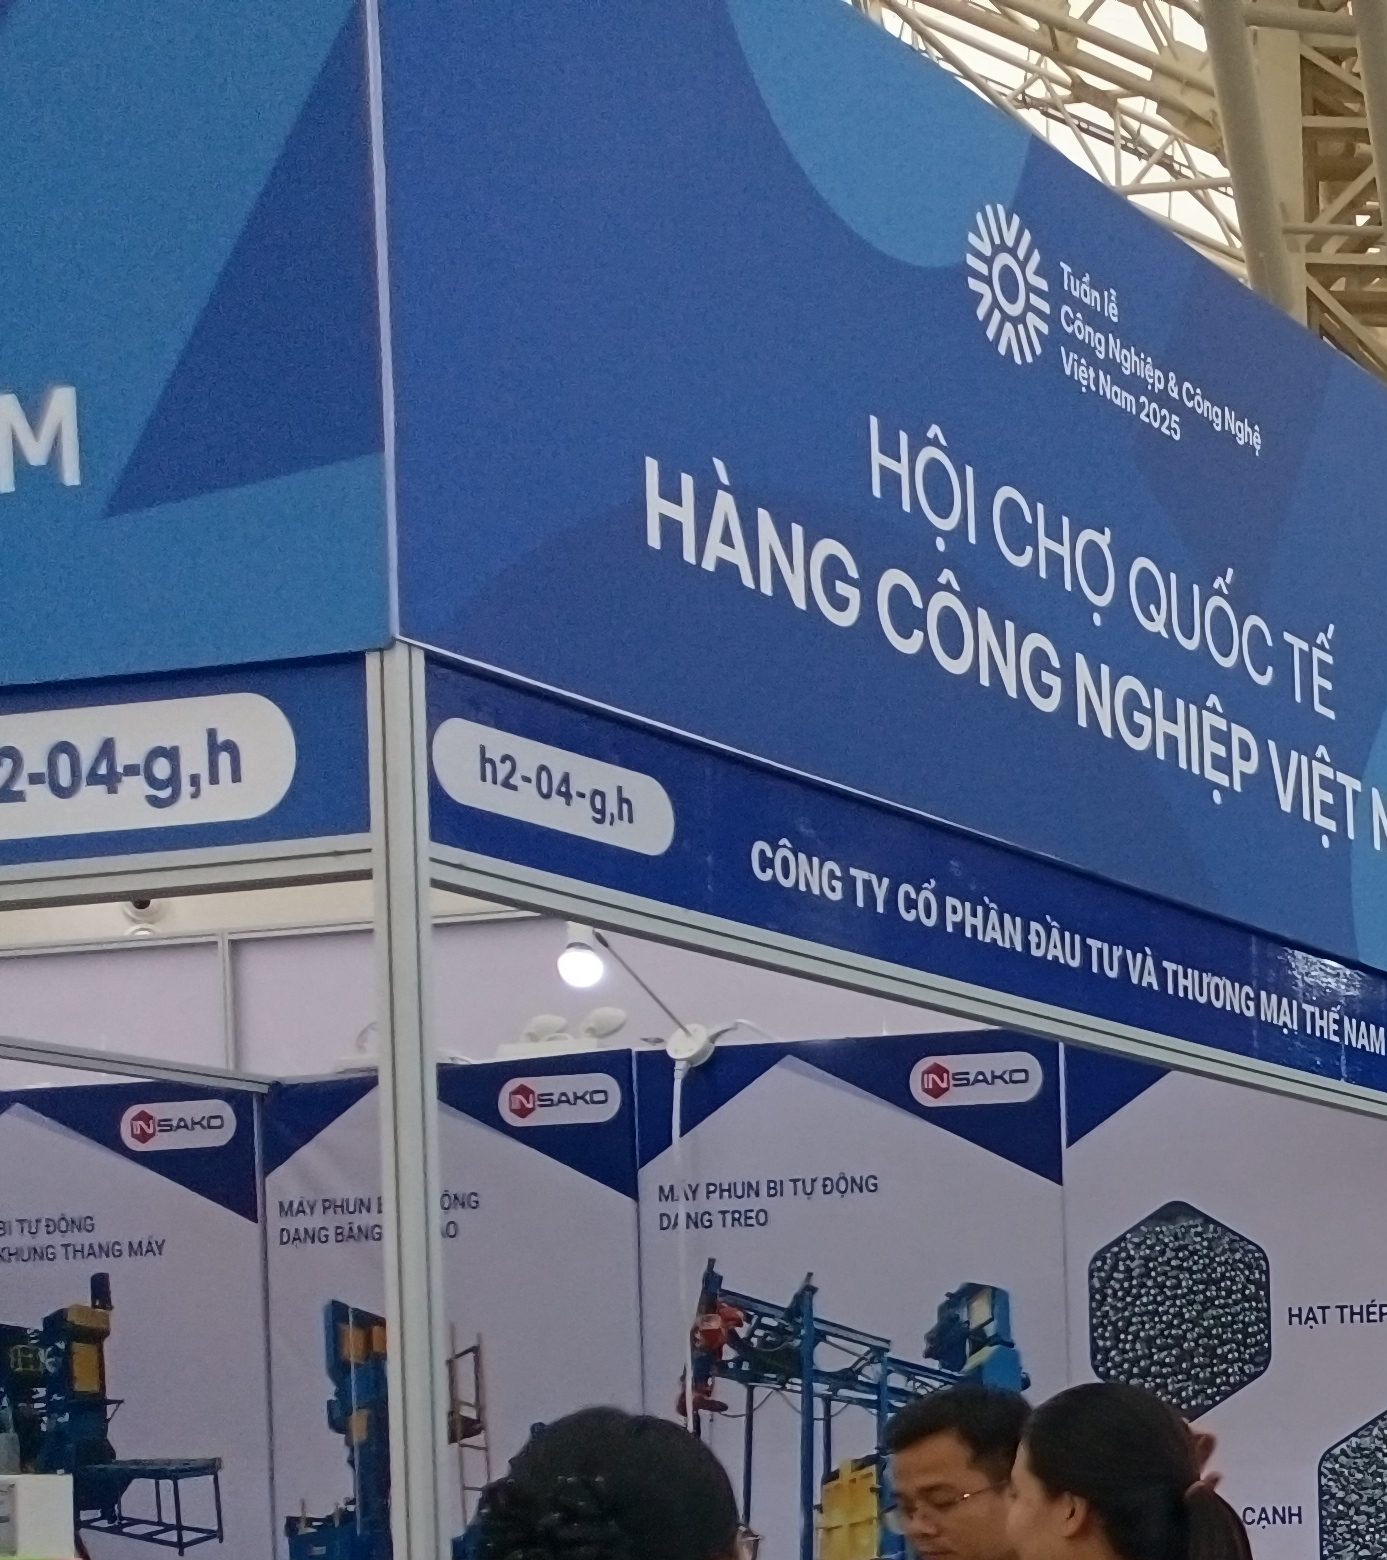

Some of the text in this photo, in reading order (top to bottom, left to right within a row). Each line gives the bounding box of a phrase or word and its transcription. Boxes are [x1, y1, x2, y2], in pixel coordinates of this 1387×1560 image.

[1060, 304, 1262, 457] Công Nghiệp & Công Nghệ
[1060, 345, 1181, 441] Việt Nam 2025
[868, 413, 1338, 720] HỘI CHỢ QUỐC TẾ
[644, 455, 860, 628] HÀNG
[878, 567, 1062, 714] CÔNG
[1076, 652, 1260, 805] NGHIỆP
[1268, 744, 1361, 849] VIỆT
[0, 726, 243, 810] 2-04-g,h
[478, 742, 636, 828] h2-04-g,h
[750, 838, 843, 901] CÔNG
[850, 867, 890, 915] TY
[897, 876, 938, 928] CỔ
[944, 893, 1023, 953] PHẦN
[1029, 911, 1082, 969] ĐẦU
[1087, 934, 1127, 977] TƯ
[1127, 939, 1159, 992] VÀ
[1162, 957, 1257, 1018] THƯƠNG
[1259, 986, 1299, 1036] MẠI
[1343, 1016, 1387, 1057] NAM
[705, 1180, 760, 1200] PHUN
[766, 1179, 784, 1198] BI
[788, 1176, 818, 1200] TỰ
[822, 1172, 879, 1199] ĐỘNG
[278, 1196, 317, 1217] MÁY
[322, 1196, 371, 1215] PHUN
[439, 1190, 480, 1214] ỘNG
[15, 1217, 42, 1239] TỰ
[45, 1213, 95, 1238] ĐỘNG
[718, 1208, 769, 1228] TREO
[61, 1240, 123, 1261] THANG
[128, 1235, 166, 1258] MÁY
[279, 1225, 330, 1248] DẠNG
[1287, 1305, 1331, 1329] HẠT
[1242, 1505, 1303, 1528] CẠNH
